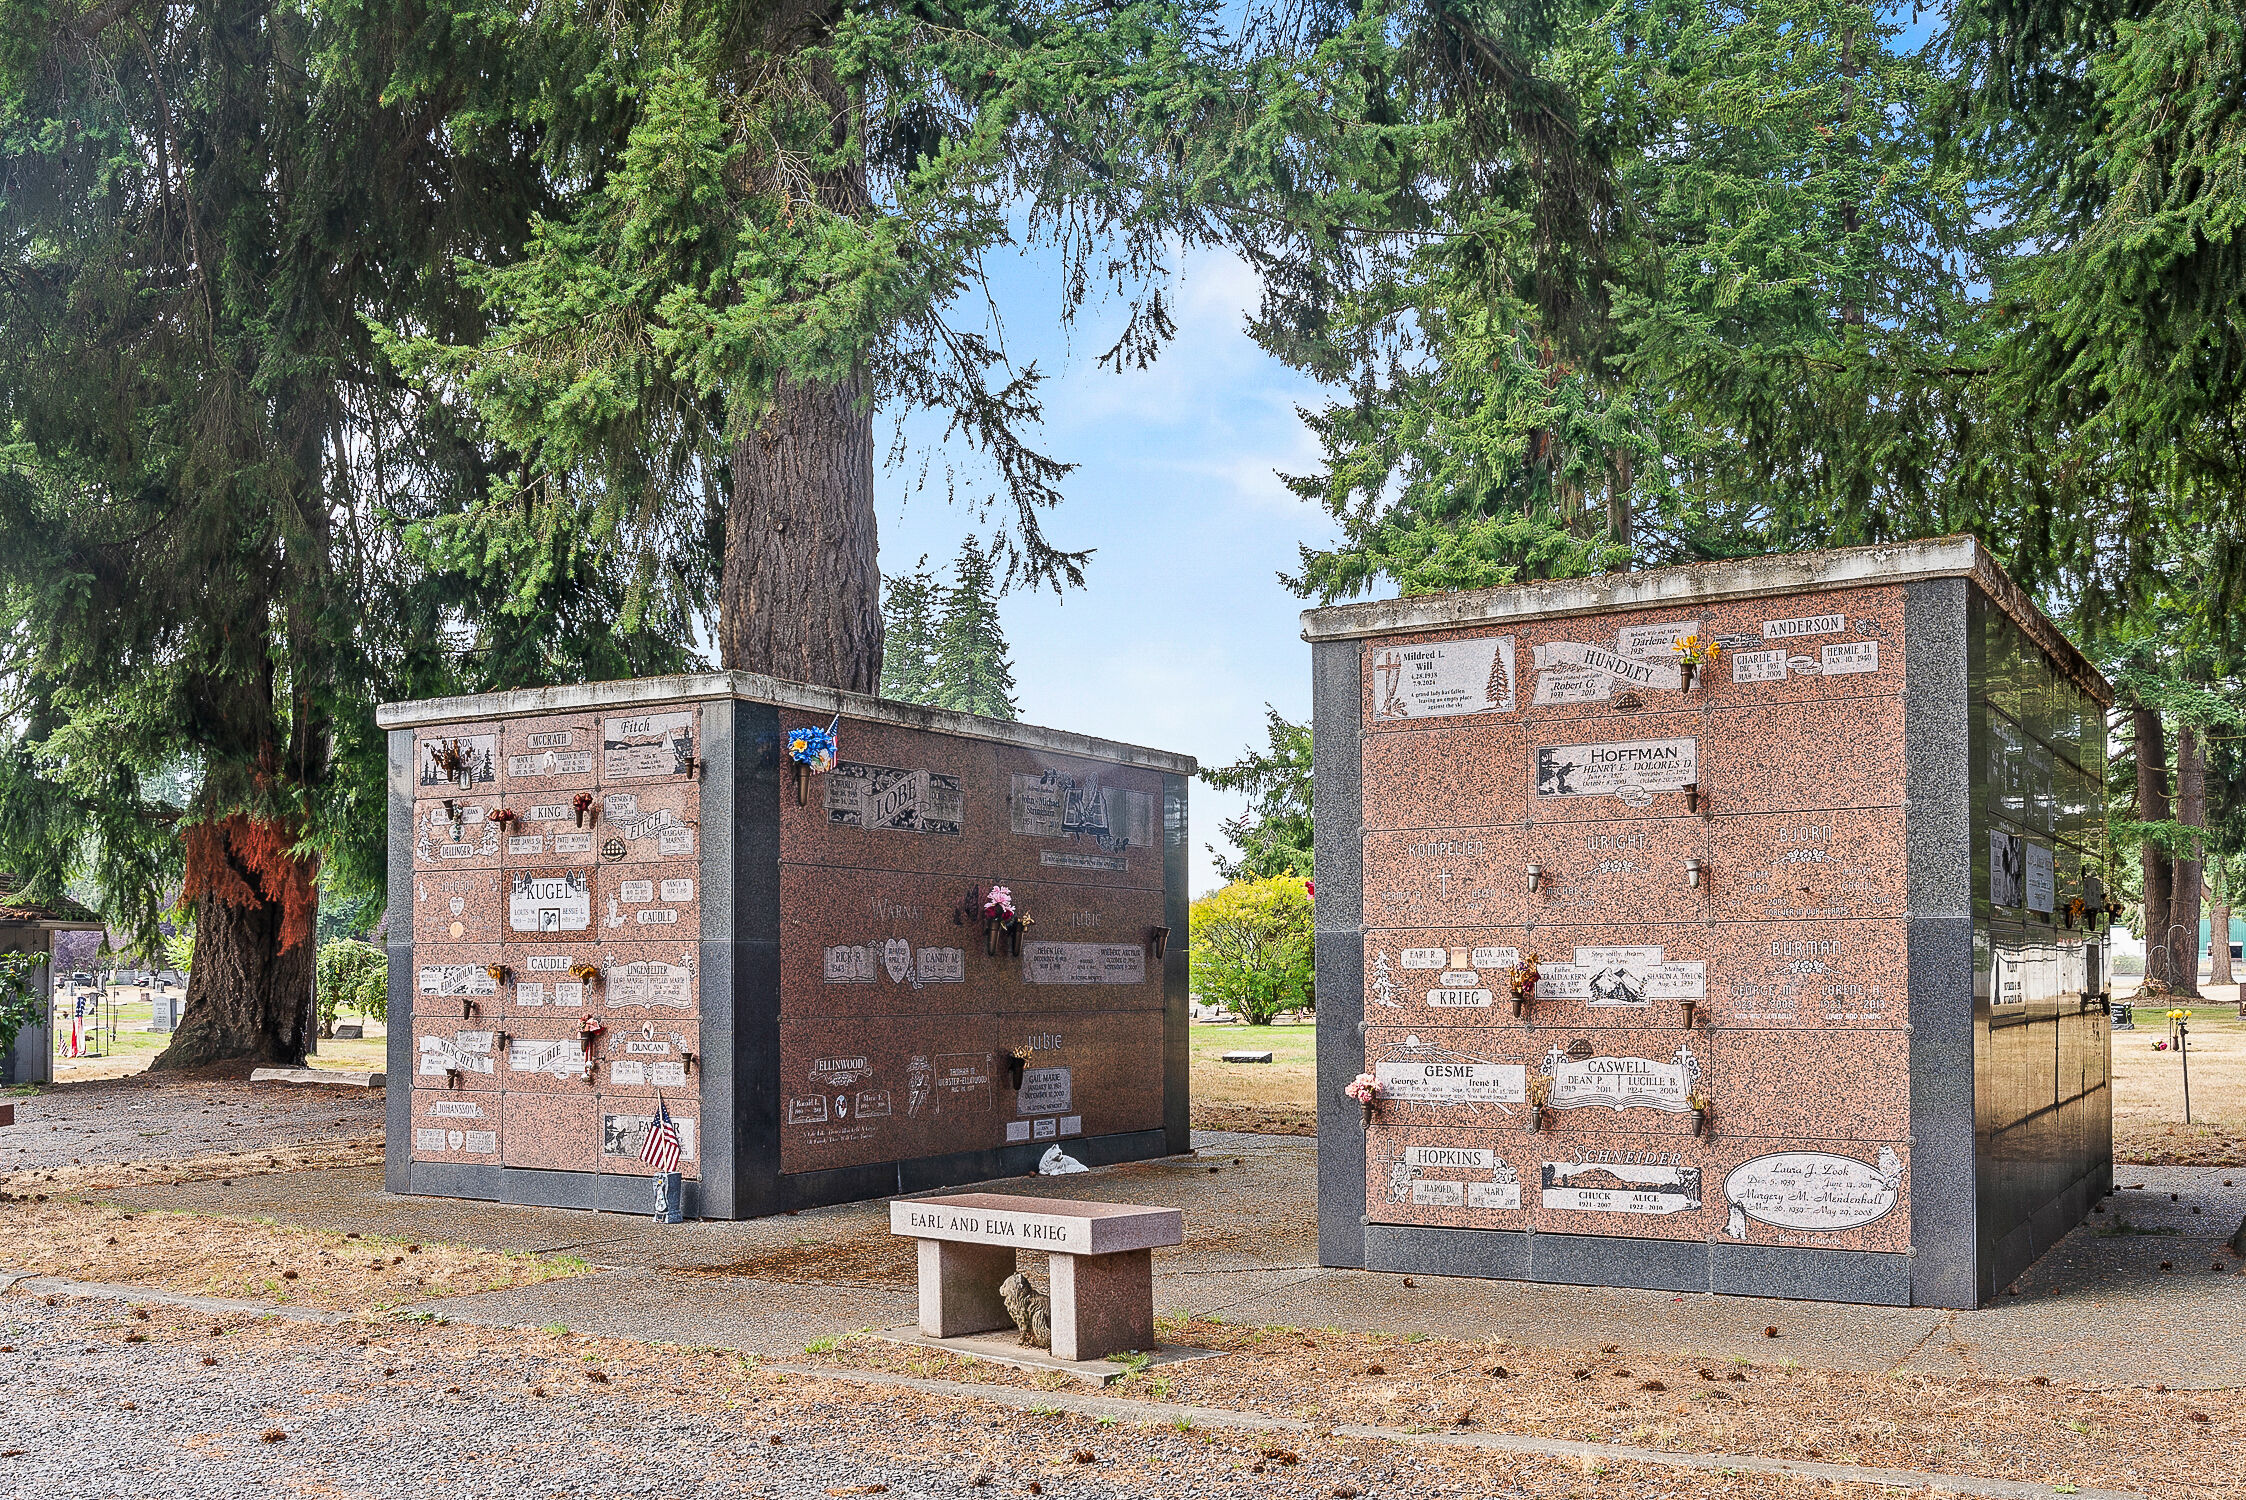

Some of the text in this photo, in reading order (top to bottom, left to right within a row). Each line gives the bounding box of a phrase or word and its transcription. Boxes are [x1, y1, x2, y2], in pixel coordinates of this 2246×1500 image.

[1769, 617, 1839, 636] ANDERSON
[1632, 634, 1667, 647] Darlene
[1403, 650, 1435, 661] Mildred
[1827, 647, 1859, 656] HERMIE
[1736, 653, 1771, 664] CHARLIE
[1416, 662, 1433, 671] Will
[1584, 650, 1653, 682] HUNDLEY
[1553, 680, 1583, 690] Robert
[621, 717, 650, 733] Fitch
[1592, 747, 1678, 762] HOFFMAN
[1583, 763, 1616, 773] HENRY
[1633, 760, 1693, 770] DOLORES D.
[876, 778, 916, 822] LOBE
[537, 807, 561, 818] KING
[630, 812, 662, 839] FITCH
[1779, 825, 1832, 842] BJORN
[1587, 834, 1645, 850] WRIGHT
[442, 846, 471, 857] DELLINGER
[440, 881, 475, 892] JOHNSON
[527, 883, 573, 900] KUGEL
[642, 911, 672, 922] CAUDLE
[1772, 940, 1841, 956] BURMAN
[835, 952, 853, 963] RICK
[925, 952, 949, 963] CANDY
[1410, 951, 1427, 959] EARL
[1475, 950, 1514, 958] ELVA JANE
[531, 958, 568, 969] CAUDLE
[1731, 985, 1775, 996] GEORGE
[1821, 984, 1864, 995] LORENE
[1440, 991, 1480, 1005] KRIEG
[1769, 1000, 1794, 1009] 2008
[1863, 1000, 1886, 1009] 2013
[632, 1043, 664, 1052] DUNCAN
[537, 1044, 562, 1069] JUBIE
[819, 1058, 864, 1071] ELLINWOOD
[1588, 1060, 1650, 1074] CASWELL
[1424, 1065, 1474, 1078] GESME
[1391, 1077, 1418, 1086] George
[1568, 1076, 1604, 1085] DEAN P.
[1628, 1077, 1678, 1086] LUCILLE B.
[1595, 1085, 1611, 1093] 2011
[437, 1103, 474, 1114] JOHANSSON
[1418, 1149, 1481, 1165] HOPKINS
[1570, 1145, 1682, 1166] SCHNEIDER
[1770, 1162, 1802, 1174] Laura
[1484, 1187, 1505, 1196] MARY
[1578, 1191, 1660, 1203] CHUCK ALICE
[1737, 1189, 1885, 1206] Margery M. Mendenhall
[1813, 1206, 1837, 1217] May
[911, 1212, 1067, 1242] EARL AND ELVA KRIEG
[1778, 1234, 1842, 1246] Best of Friends
